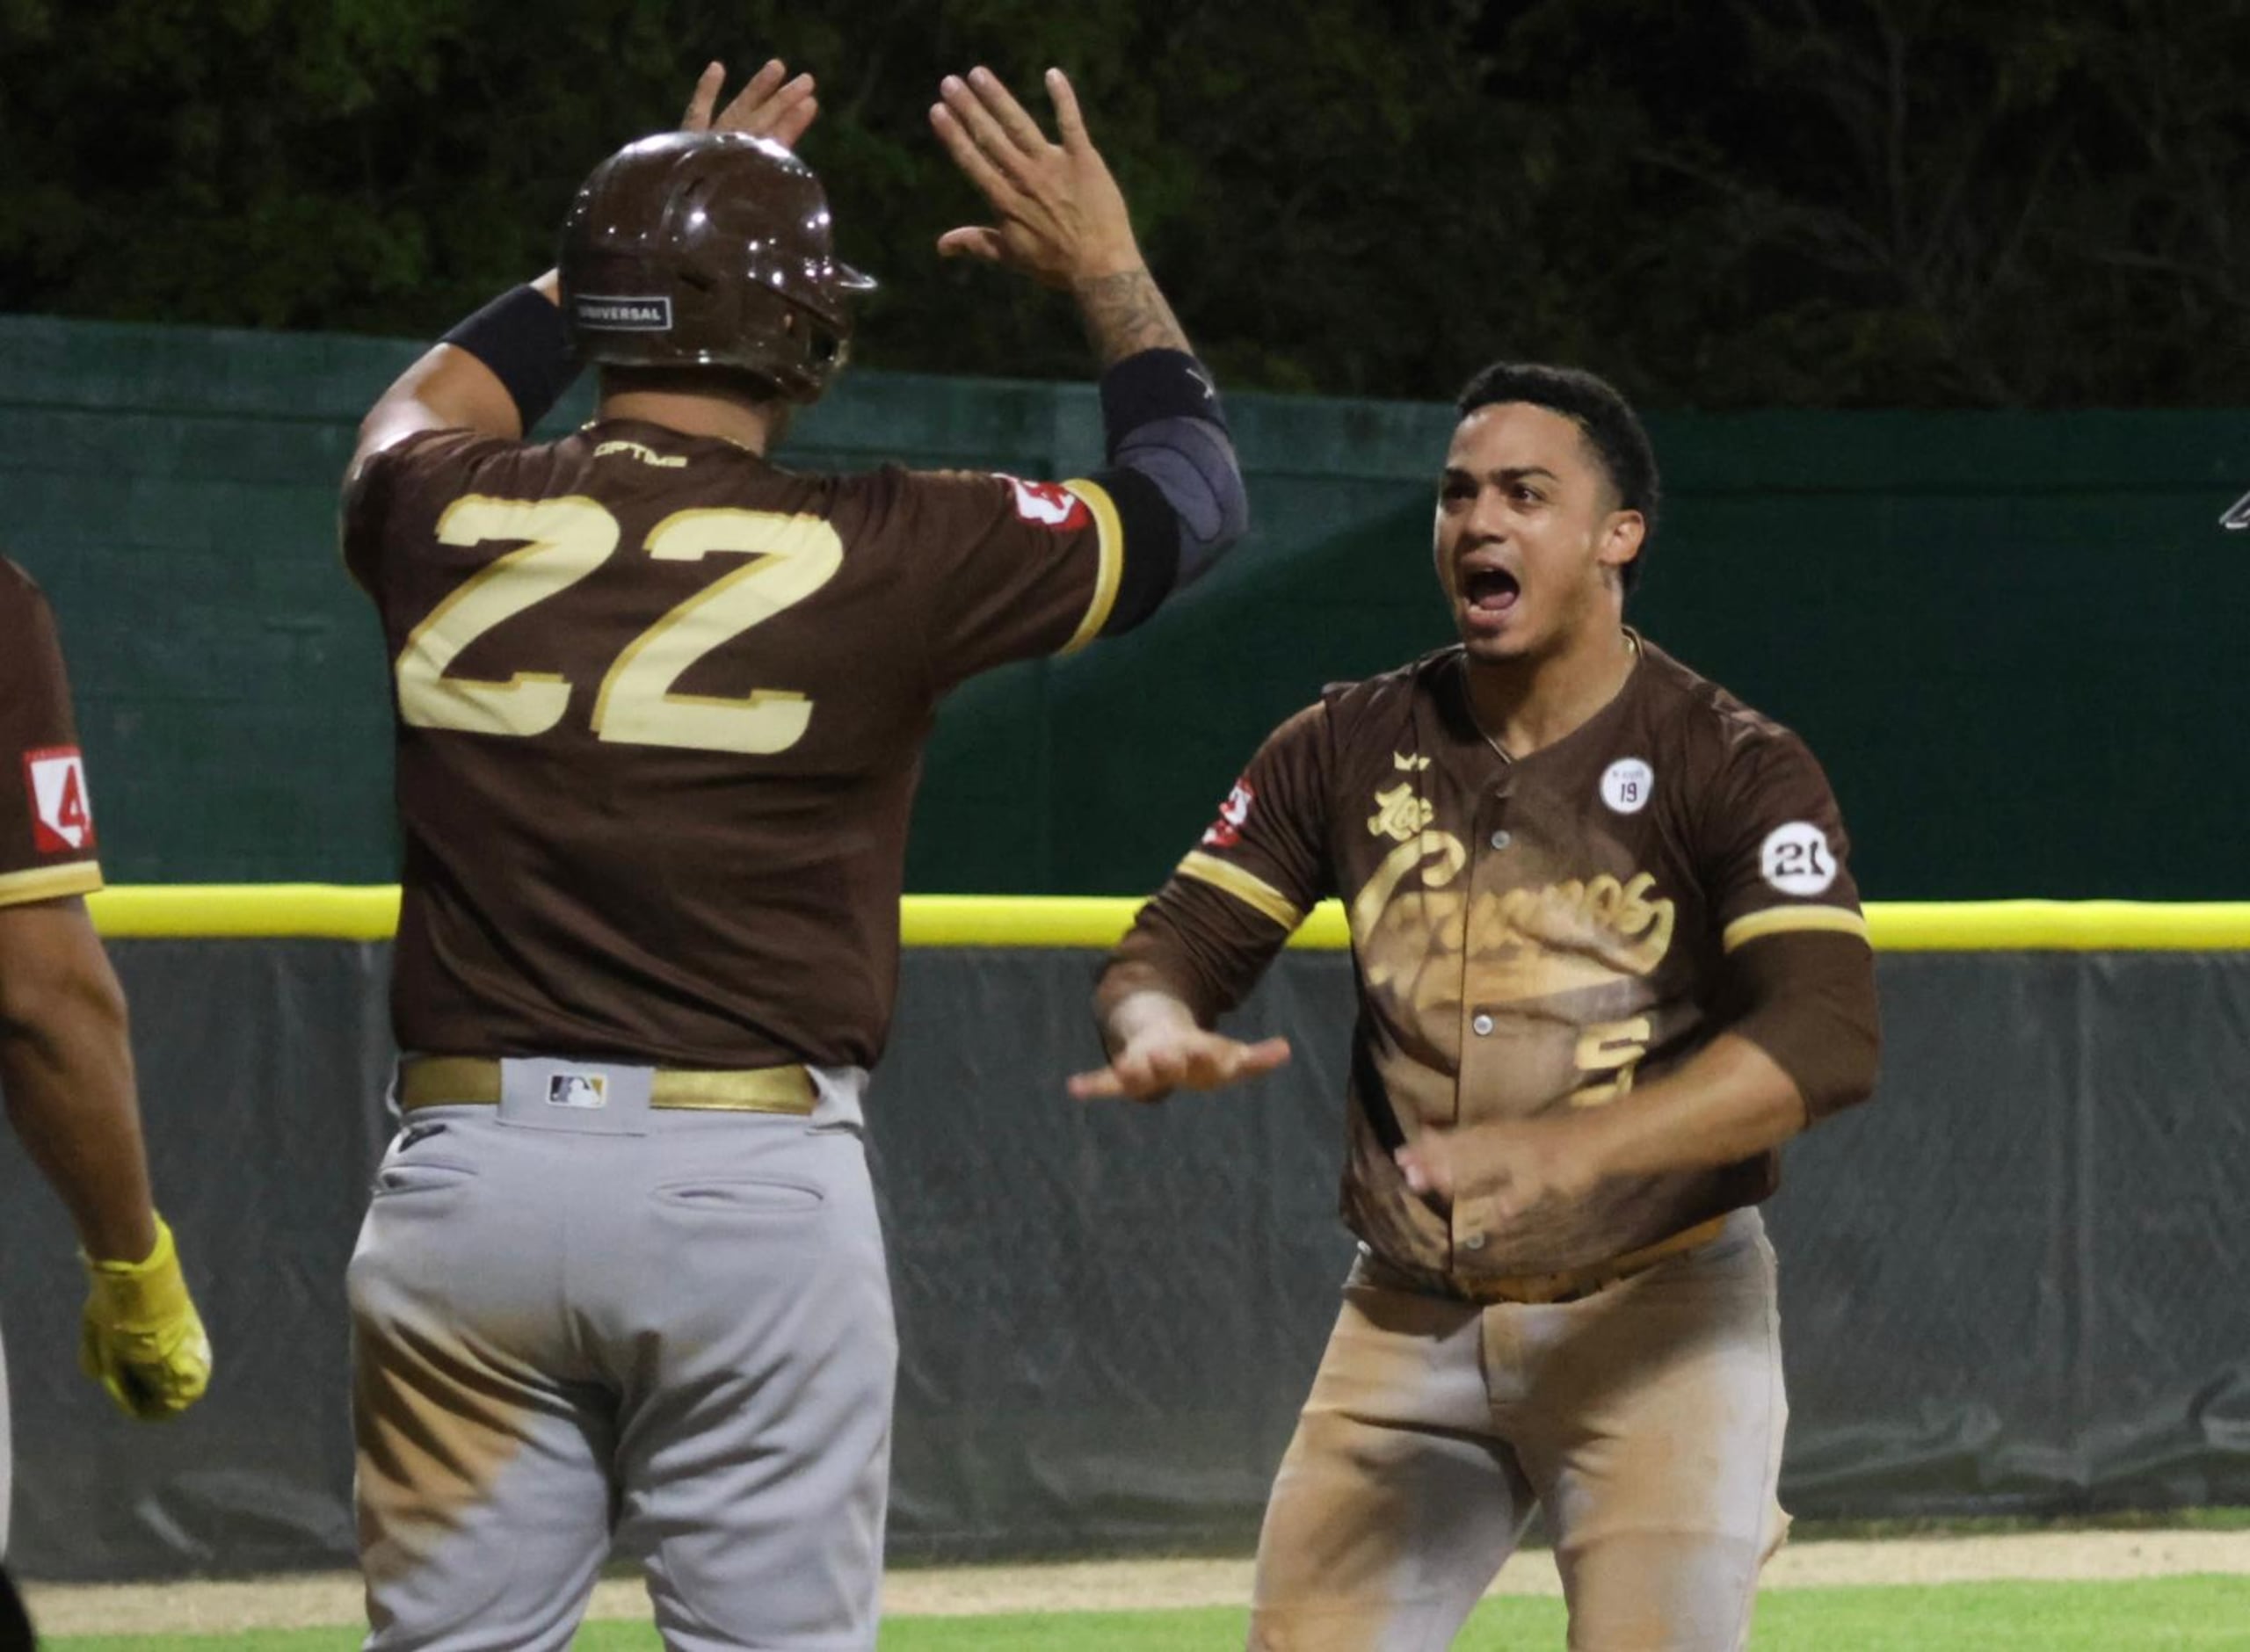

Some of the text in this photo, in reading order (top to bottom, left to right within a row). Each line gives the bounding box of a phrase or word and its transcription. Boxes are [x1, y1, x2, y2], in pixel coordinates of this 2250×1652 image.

[396, 493, 843, 754] 22
[1621, 781, 1637, 803] 19
[1775, 840, 1825, 877] 21
